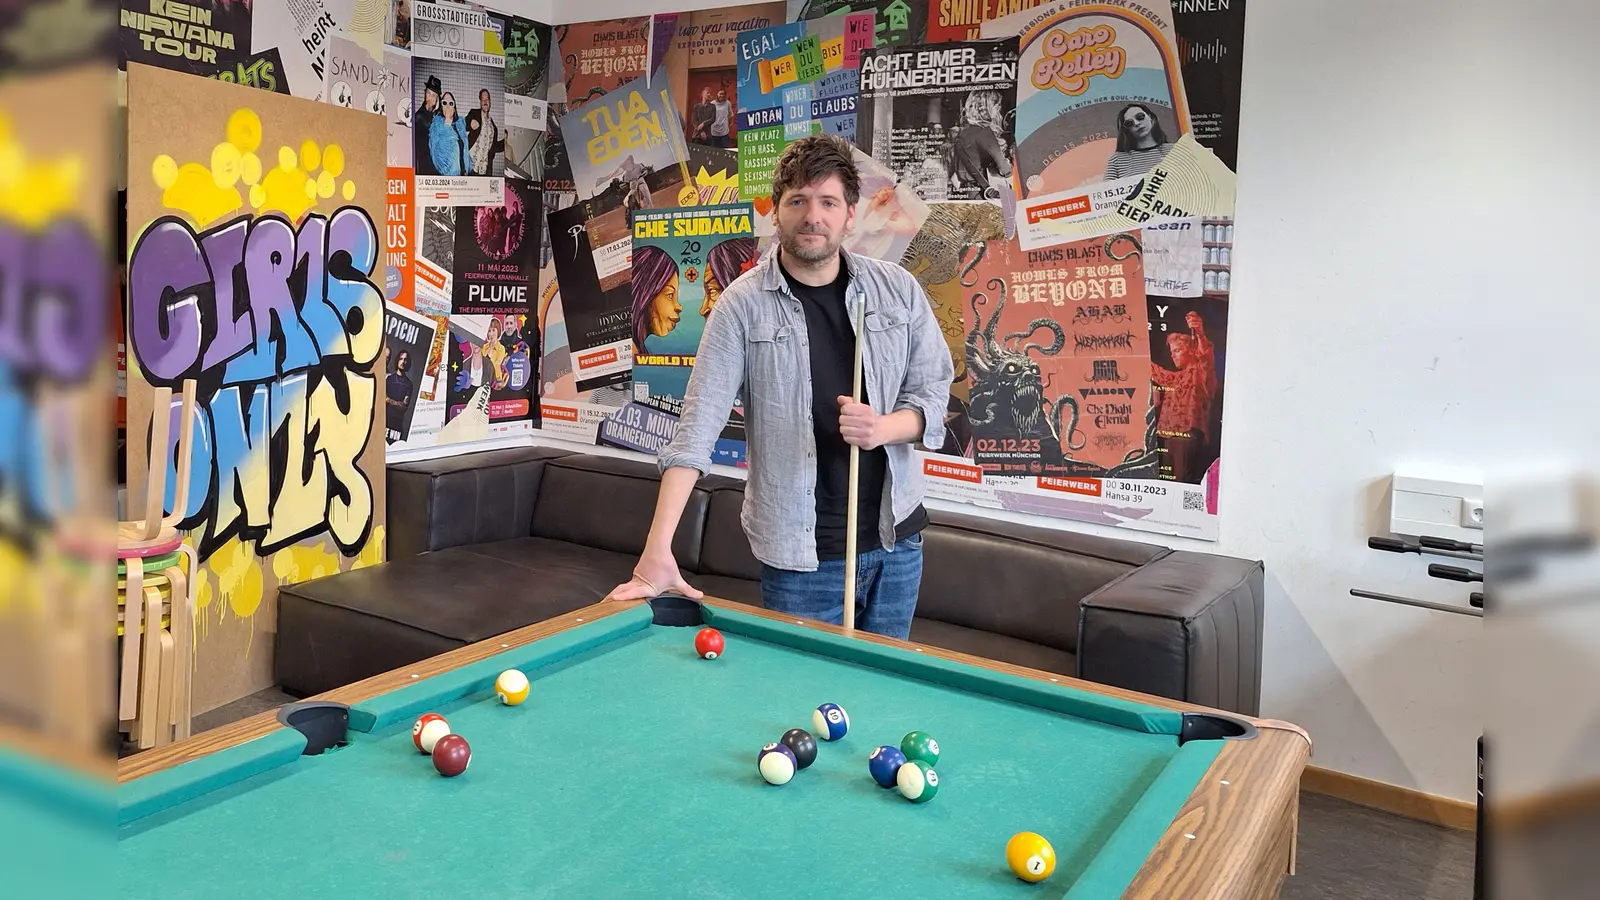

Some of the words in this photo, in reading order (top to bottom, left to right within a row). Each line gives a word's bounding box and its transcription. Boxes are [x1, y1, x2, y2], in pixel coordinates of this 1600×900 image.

[149, 0, 213, 27] KEIN
[1069, 0, 1127, 9] FEIERWERK
[1128, 2, 1168, 30] PRESENT
[120, 9, 236, 50] NIRVANA
[302, 10, 337, 55] heißt
[701, 22, 724, 41] year
[725, 16, 771, 33] vacation
[849, 18, 869, 34] WIE
[139, 33, 218, 64] TOUR
[677, 38, 726, 49] EXPEDITION
[742, 32, 780, 61] EGAL
[1045, 27, 1111, 57] Caro
[443, 50, 454, 58] DAS
[691, 46, 723, 56] TOUR
[822, 44, 842, 60] BIST
[800, 52, 813, 67] DU
[861, 53, 913, 74] ACHT
[916, 48, 976, 69] EIMER
[773, 61, 792, 77] WER
[798, 63, 825, 81] LIEBST
[860, 62, 1017, 91] HÜHNERHERZEN
[1035, 48, 1121, 92] Kelley
[820, 72, 848, 87] WOVOR
[789, 105, 804, 119] DU
[1058, 104, 1073, 115] LIVE
[1075, 98, 1092, 110] WITH
[1150, 98, 1170, 107] BAND
[747, 108, 783, 126] WORAN
[836, 118, 855, 132] WER
[744, 131, 759, 142] KEIN
[760, 129, 780, 141] PLATZ
[744, 144, 757, 155] FÜR
[1043, 150, 1062, 167] DEC
[1082, 131, 1109, 144] 2023
[425, 179, 450, 187] 02.03.2024
[545, 180, 576, 190] 02.12.
[1139, 168, 1168, 209] JAHRE
[1093, 192, 1102, 201] FR
[1030, 201, 1087, 219] FEIERWERK
[1117, 202, 1151, 223] EIER
[1152, 200, 1190, 217] RADI
[635, 220, 669, 239] CHE
[673, 215, 752, 237] SUDAKA
[682, 240, 701, 255] 20
[1028, 247, 1064, 264] CHAOS
[1066, 245, 1102, 260] BLAST
[501, 264, 519, 273] 2023
[680, 256, 701, 266] AÑOS
[498, 273, 529, 281] KRANHALLE
[1075, 264, 1124, 278] FROM
[129, 206, 387, 389] GIRLS
[468, 284, 527, 303] PLUME
[1011, 277, 1127, 307] BEYOND
[1155, 305, 1169, 318] Y
[581, 353, 615, 366] FEIERWERK
[636, 355, 680, 366] WORLD
[542, 408, 576, 418] FEIERWERK
[672, 405, 682, 415] 202
[1086, 403, 1104, 415] The
[1105, 403, 1132, 416] Night
[1094, 414, 1130, 429] Eternal
[977, 438, 1041, 452] 02.12.23
[927, 463, 978, 479] FEIERWERK
[1041, 477, 1097, 491] FEIERWERK
[1106, 480, 1117, 489] DO
[1119, 481, 1167, 496] 30.11.2023
[1105, 490, 1130, 502] Hansa
[1132, 494, 1143, 503] 39
[829, 710, 839, 721] 10
